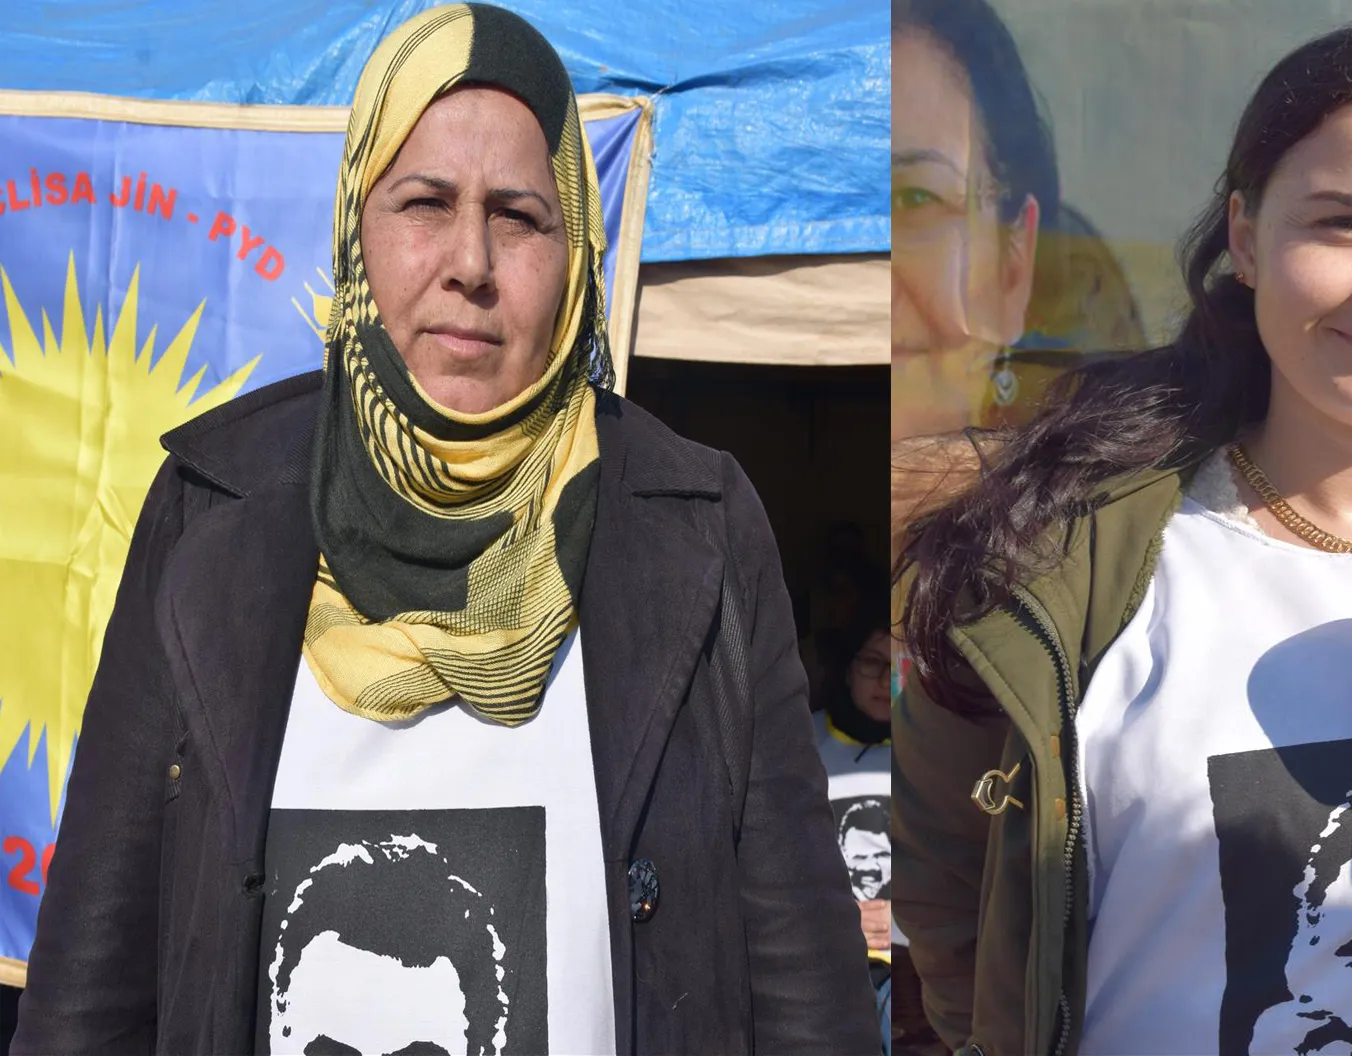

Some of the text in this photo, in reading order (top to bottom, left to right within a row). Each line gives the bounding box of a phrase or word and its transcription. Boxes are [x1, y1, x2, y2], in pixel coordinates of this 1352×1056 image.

[0, 167, 97, 216] LİSA
[208, 211, 286, 282] PYD
[2, 835, 56, 897] 2
